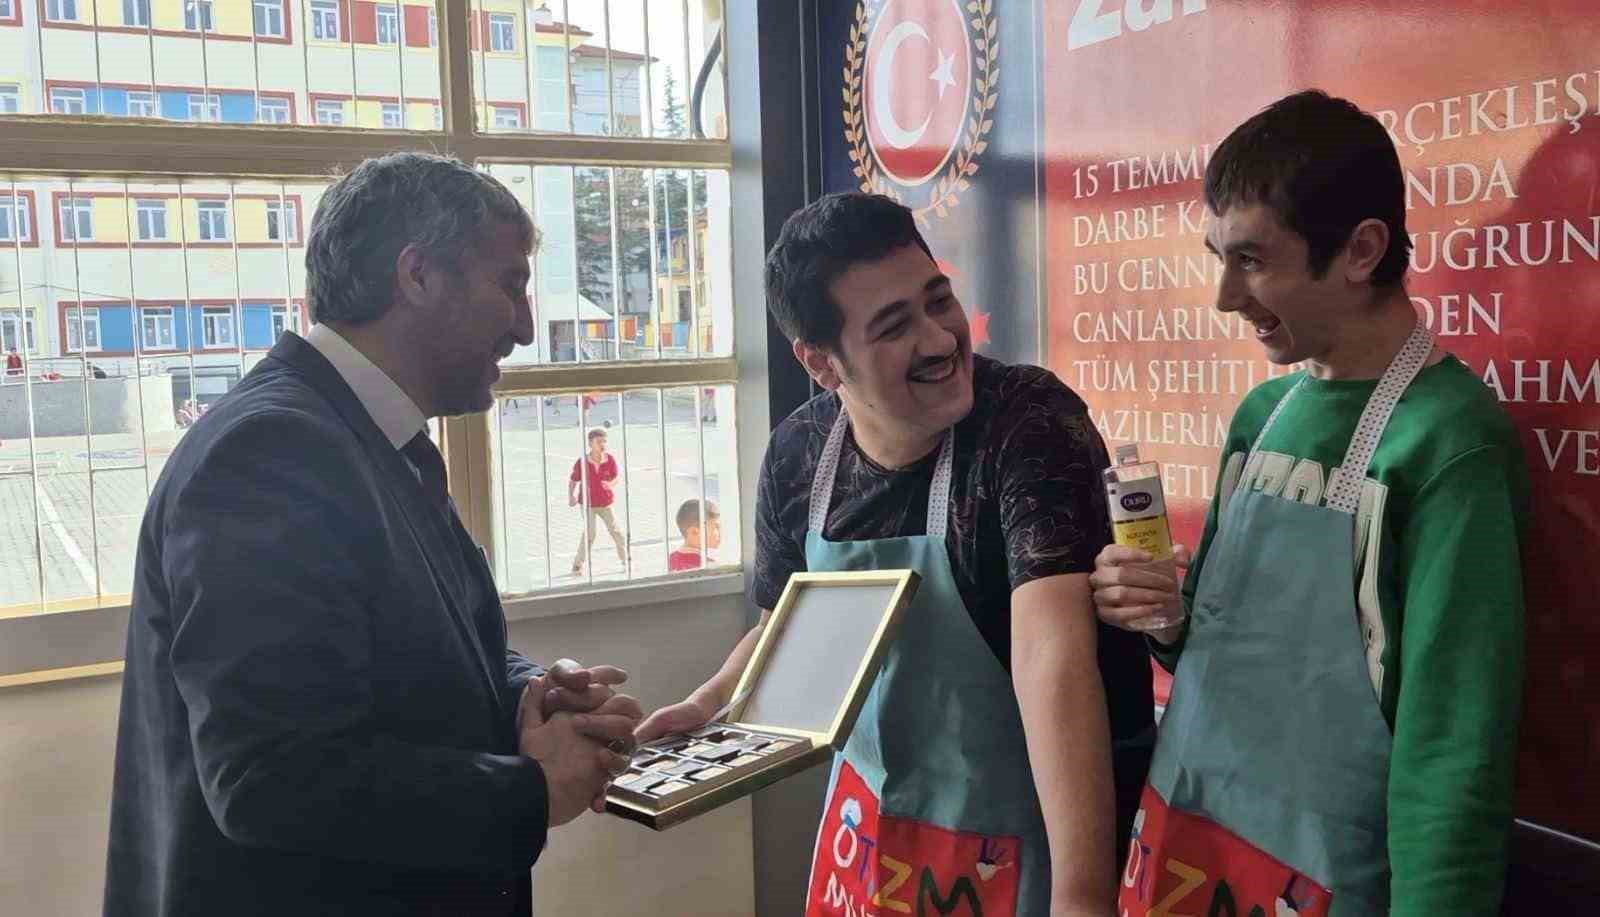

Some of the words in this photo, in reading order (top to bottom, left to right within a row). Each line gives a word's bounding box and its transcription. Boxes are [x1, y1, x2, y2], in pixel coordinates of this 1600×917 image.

[1073, 165, 1099, 199] 15
[1072, 204, 1166, 248] DARBE
[1074, 262, 1109, 295] BU
[1072, 355, 1137, 392] TÜM
